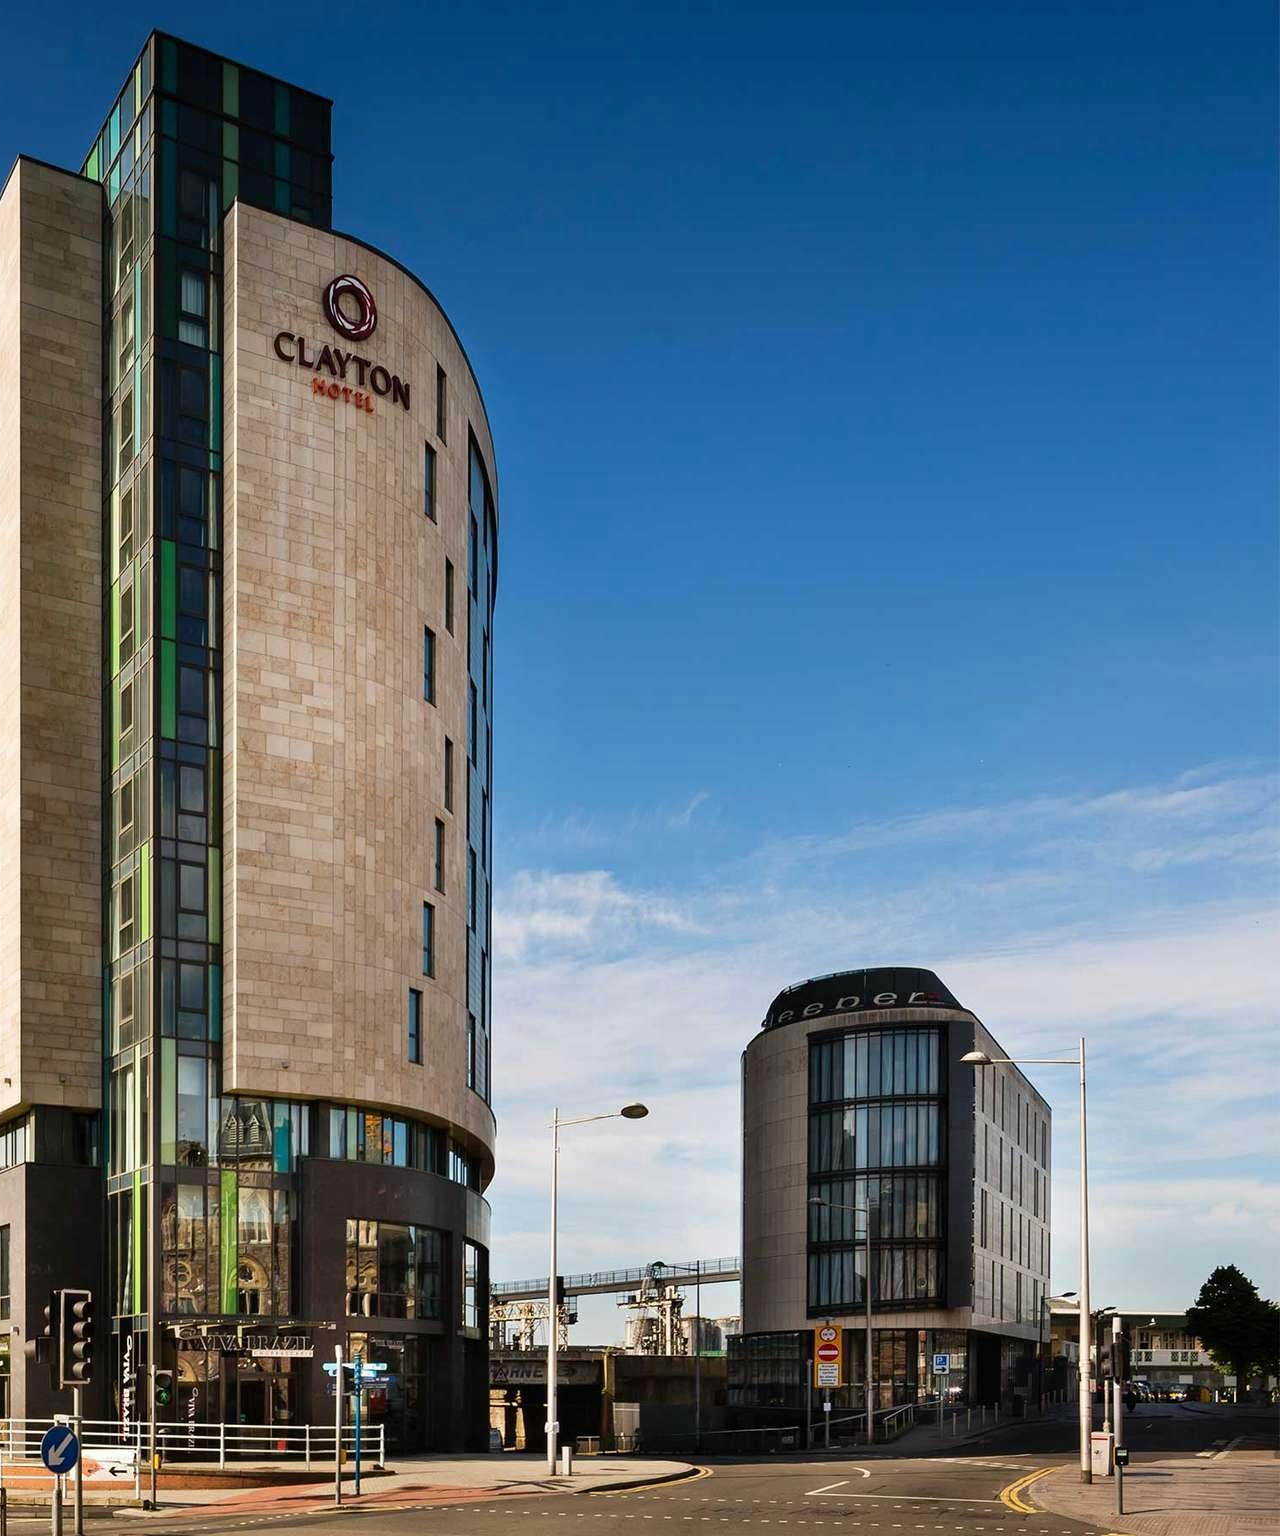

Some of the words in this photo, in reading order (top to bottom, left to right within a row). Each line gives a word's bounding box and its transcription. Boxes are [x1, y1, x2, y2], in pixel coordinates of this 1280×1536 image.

[273, 332, 411, 411] CLAYTON
[311, 377, 376, 413] HOTEL
[246, 1335, 315, 1351] BRAZIL
